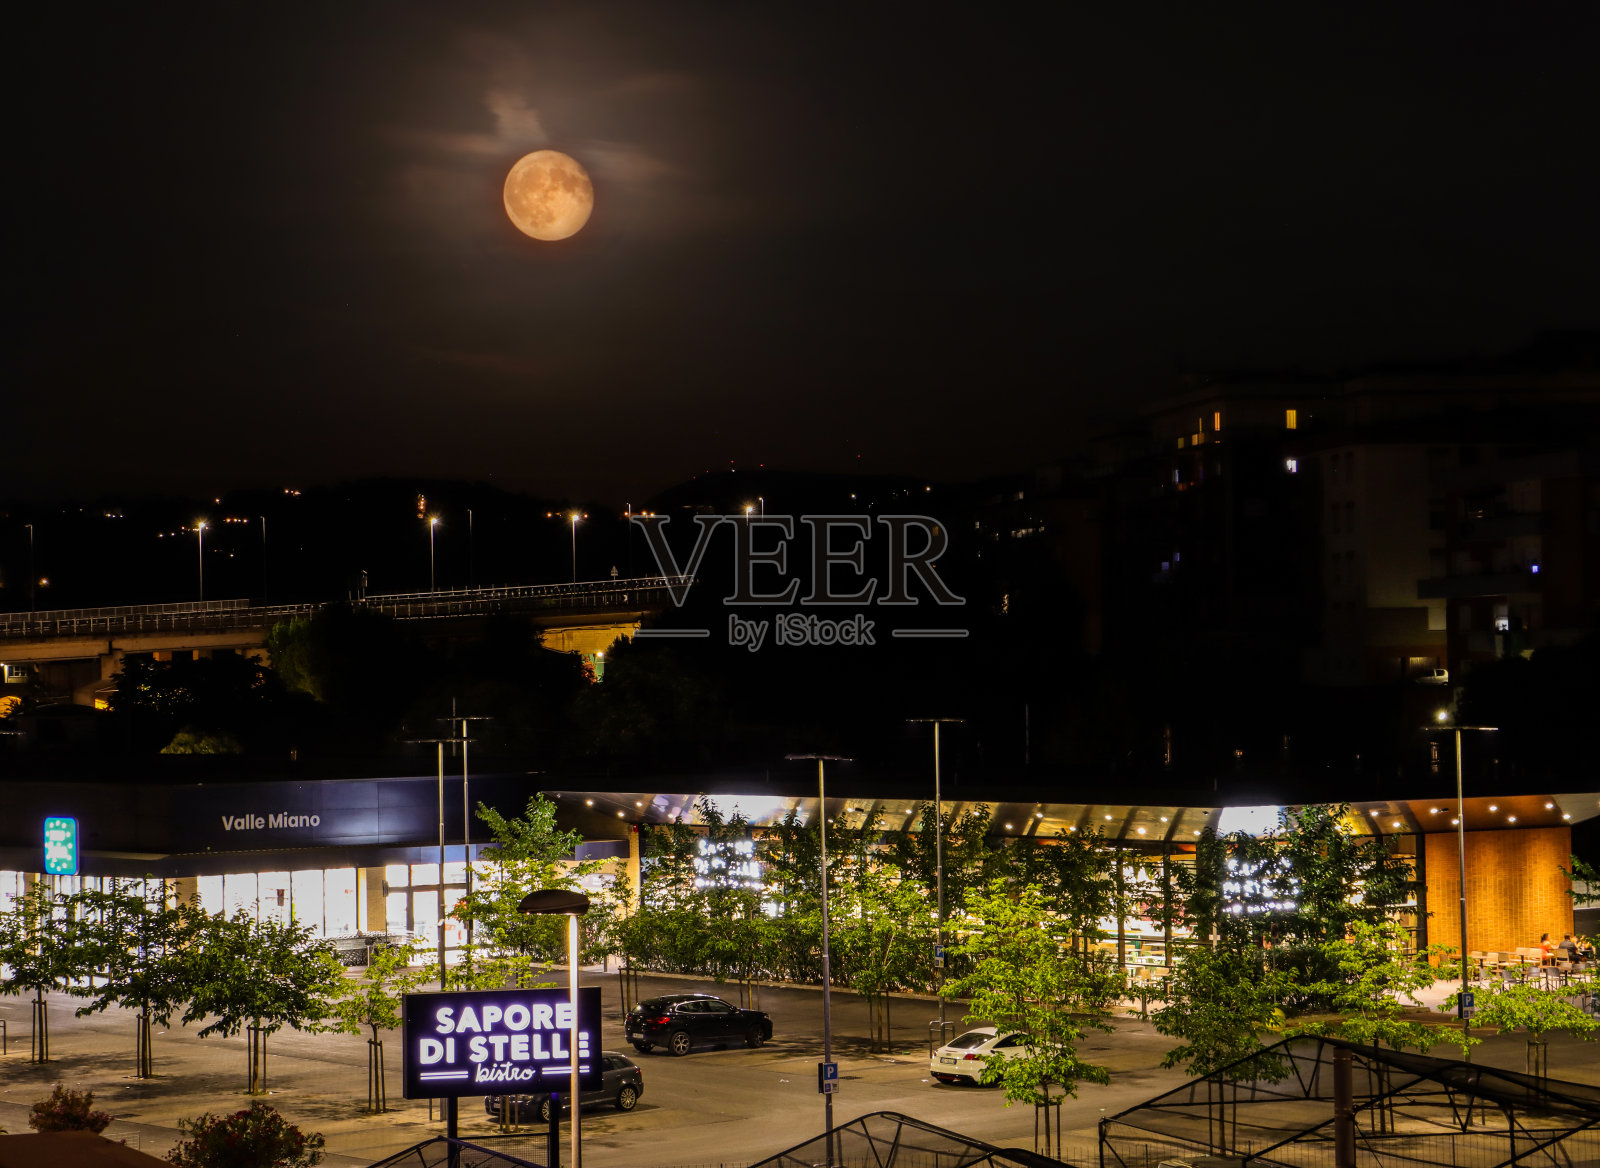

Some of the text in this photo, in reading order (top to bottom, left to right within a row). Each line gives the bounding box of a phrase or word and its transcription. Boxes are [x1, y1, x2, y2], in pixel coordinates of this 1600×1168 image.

[221, 811, 321, 831] Valle Miano
[435, 1003, 574, 1034] SAPORE
[419, 1037, 455, 1065] DI
[475, 1061, 536, 1083] bistro
[827, 1066, 835, 1078] P
